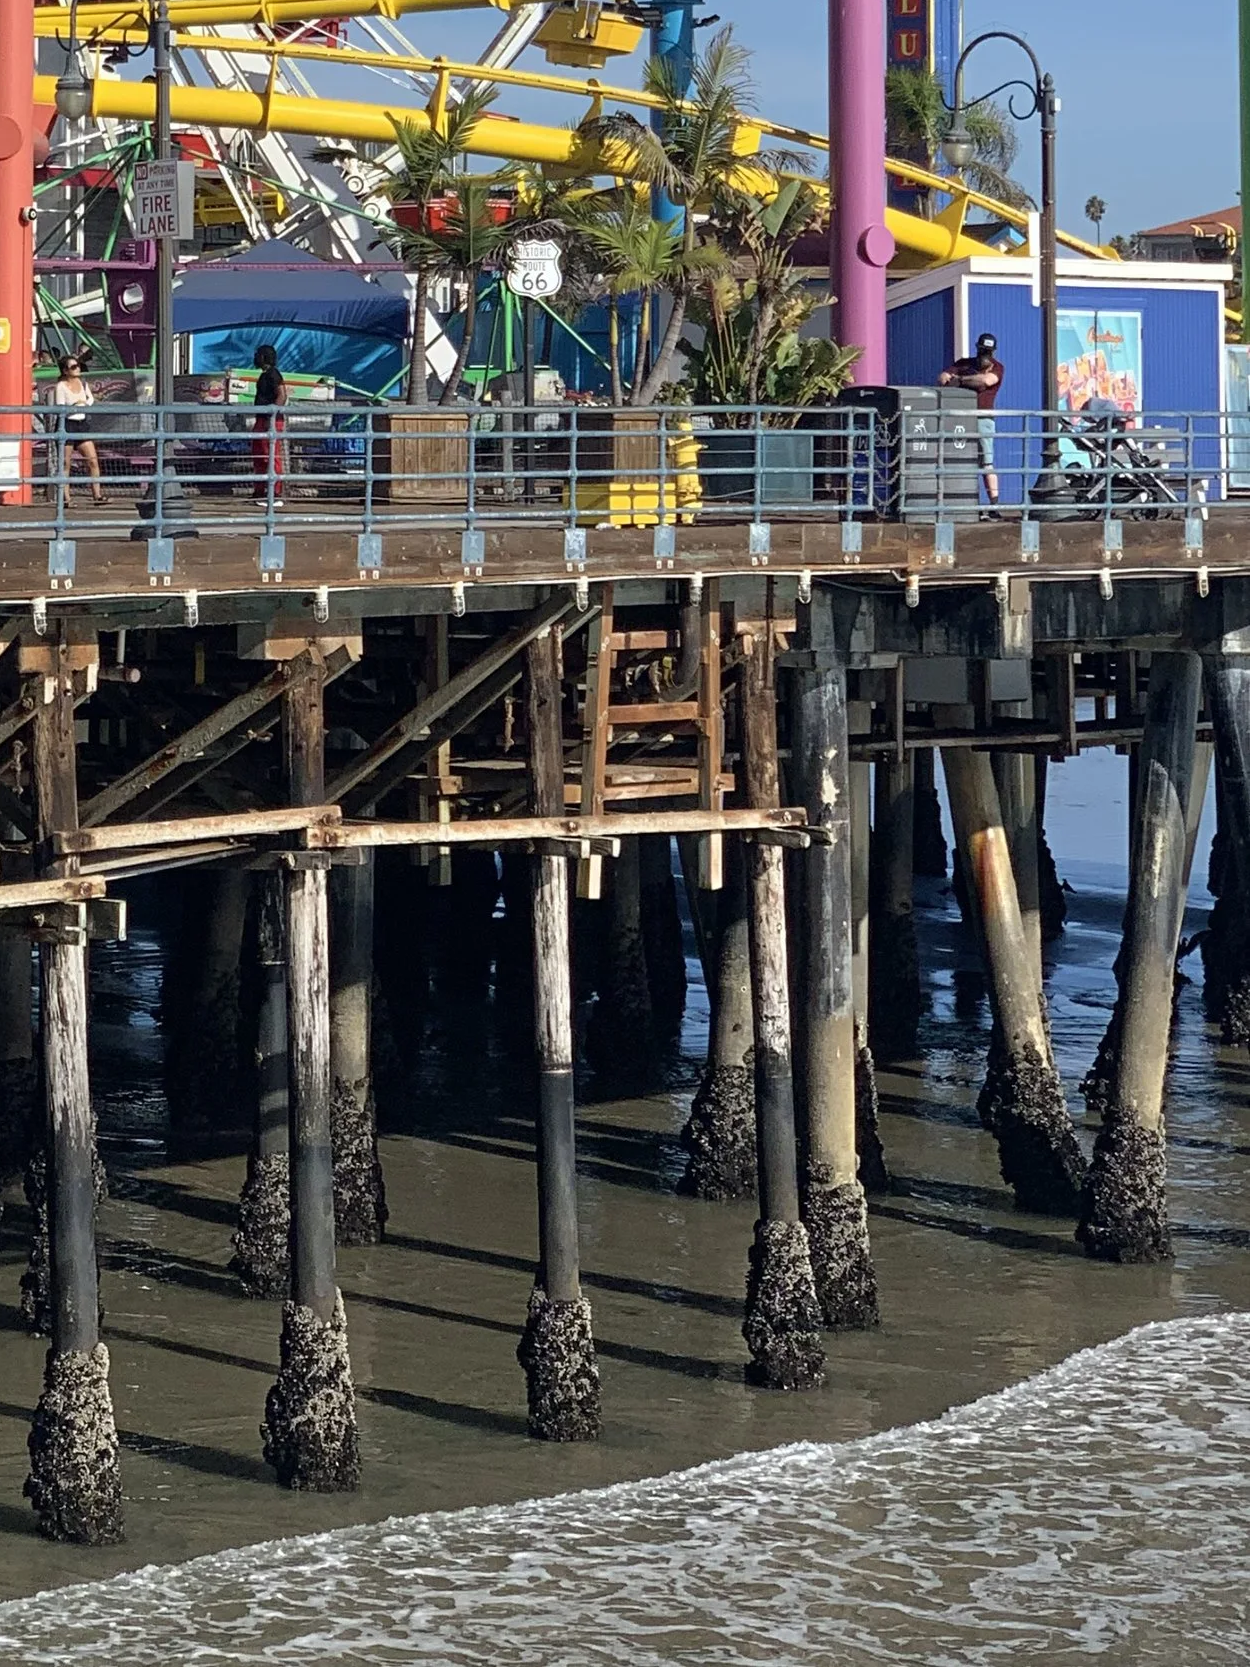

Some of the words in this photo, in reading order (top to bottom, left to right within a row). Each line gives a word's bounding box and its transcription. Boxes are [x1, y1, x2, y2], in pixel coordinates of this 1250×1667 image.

[136, 165, 147, 179] NO
[149, 164, 176, 176] PARKING
[138, 181, 145, 191] AT
[146, 181, 158, 190] ANY
[160, 178, 175, 188] TIME
[142, 194, 172, 215] FIRE
[140, 214, 176, 236] LANE
[523, 261, 546, 272] ROUTE
[522, 271, 548, 291] 66
